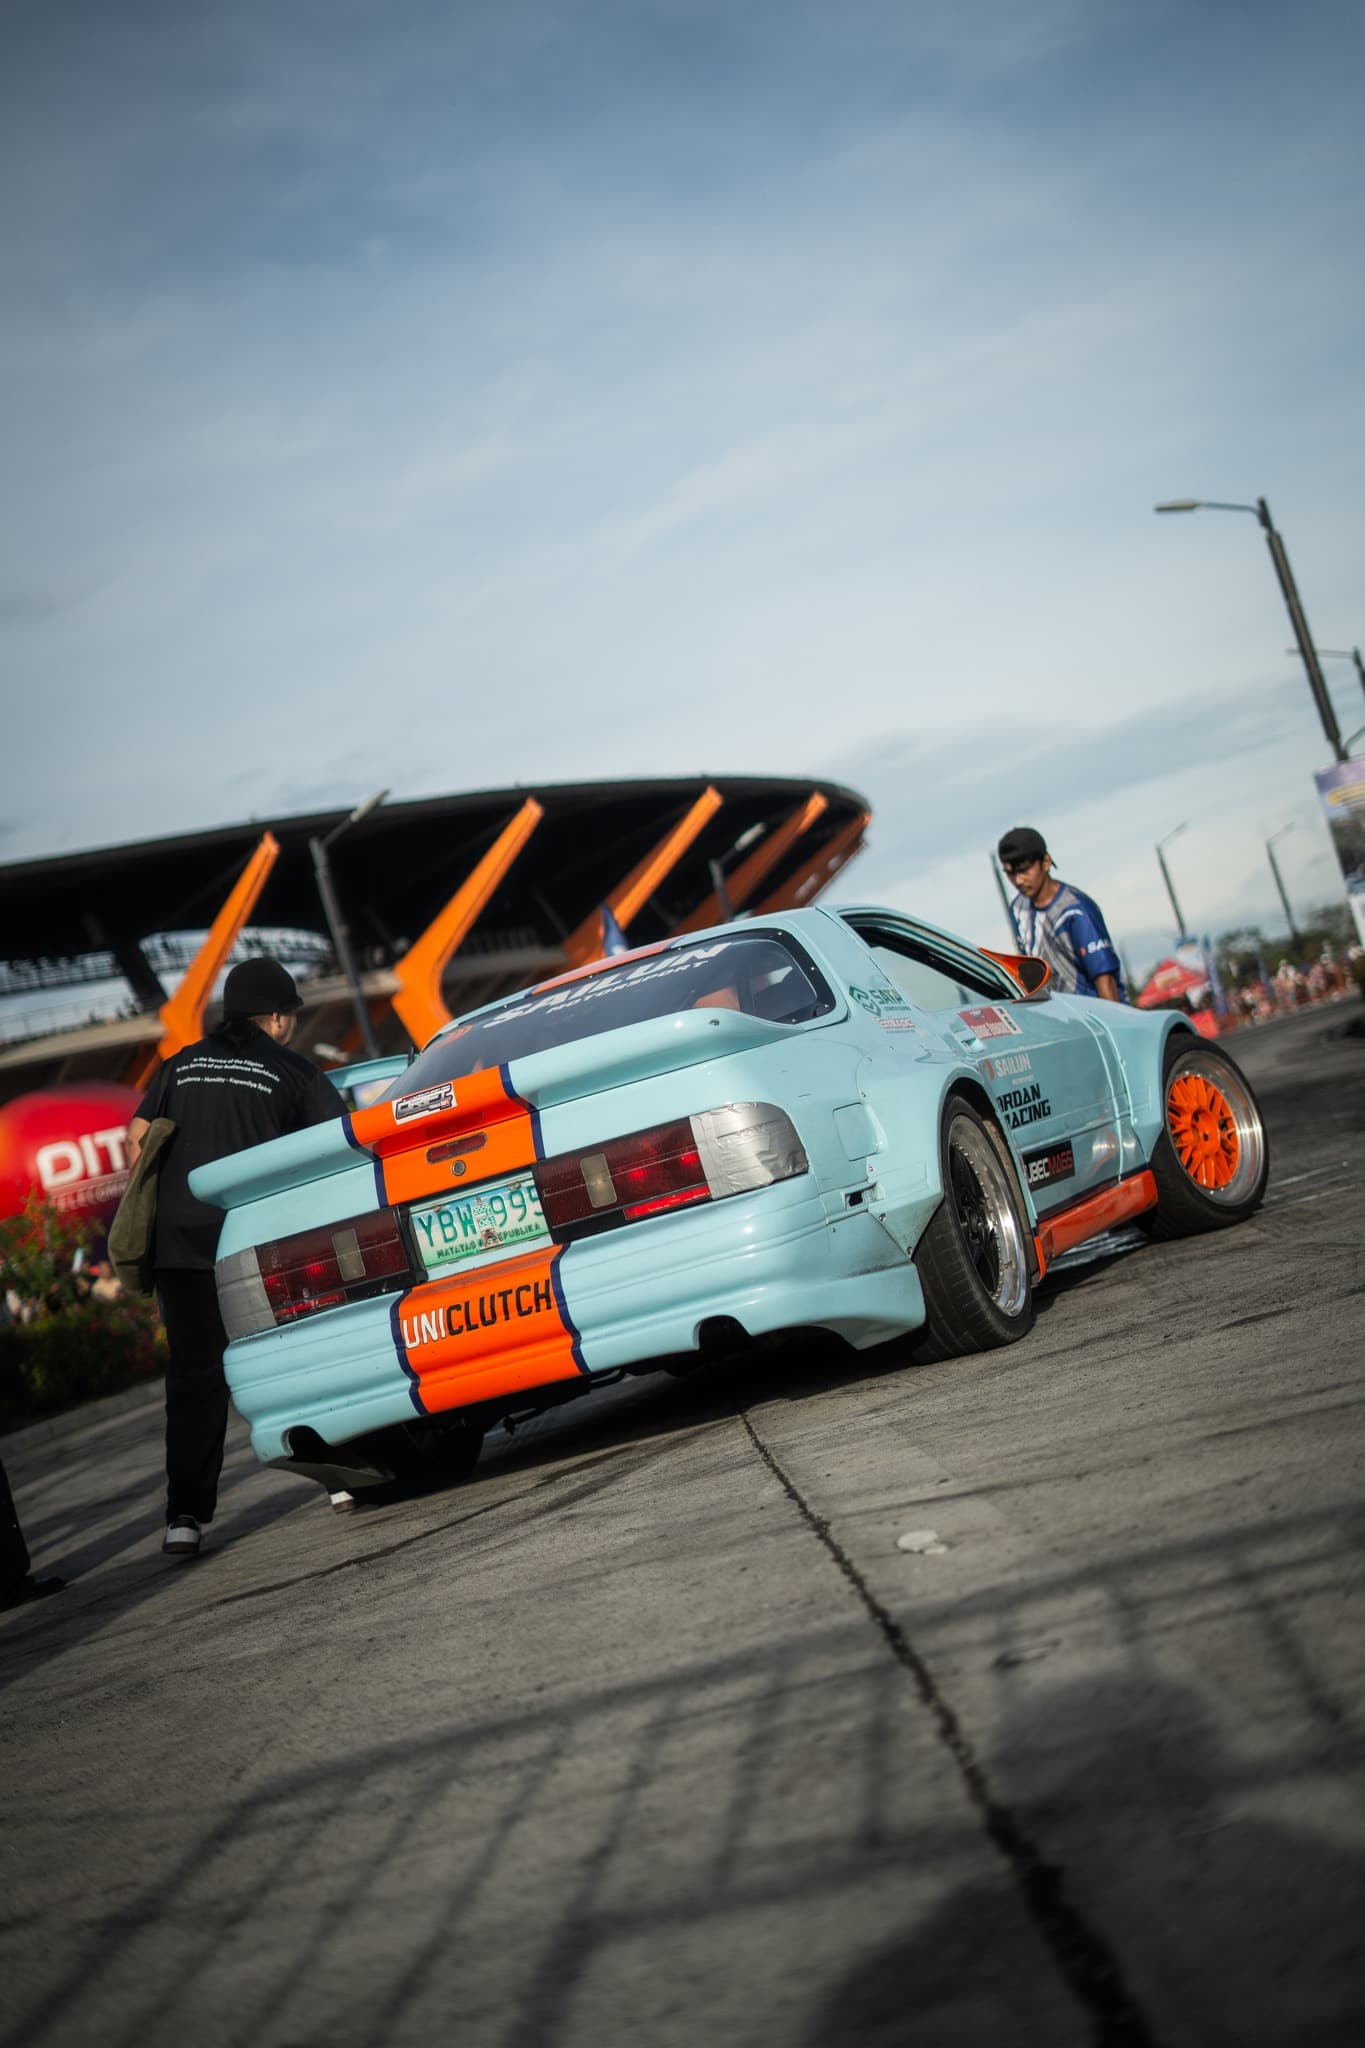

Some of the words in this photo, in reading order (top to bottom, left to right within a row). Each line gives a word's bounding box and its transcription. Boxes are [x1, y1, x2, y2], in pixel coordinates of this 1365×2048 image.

[483, 942, 732, 1029] SAILUN
[545, 961, 709, 1014] MOTORSPORT
[995, 1053, 1031, 1077] SAILUN
[418, 1203, 477, 1248] YBW
[437, 1241, 476, 1259] MATATAG
[402, 1278, 553, 1350] UNICLUTCH
